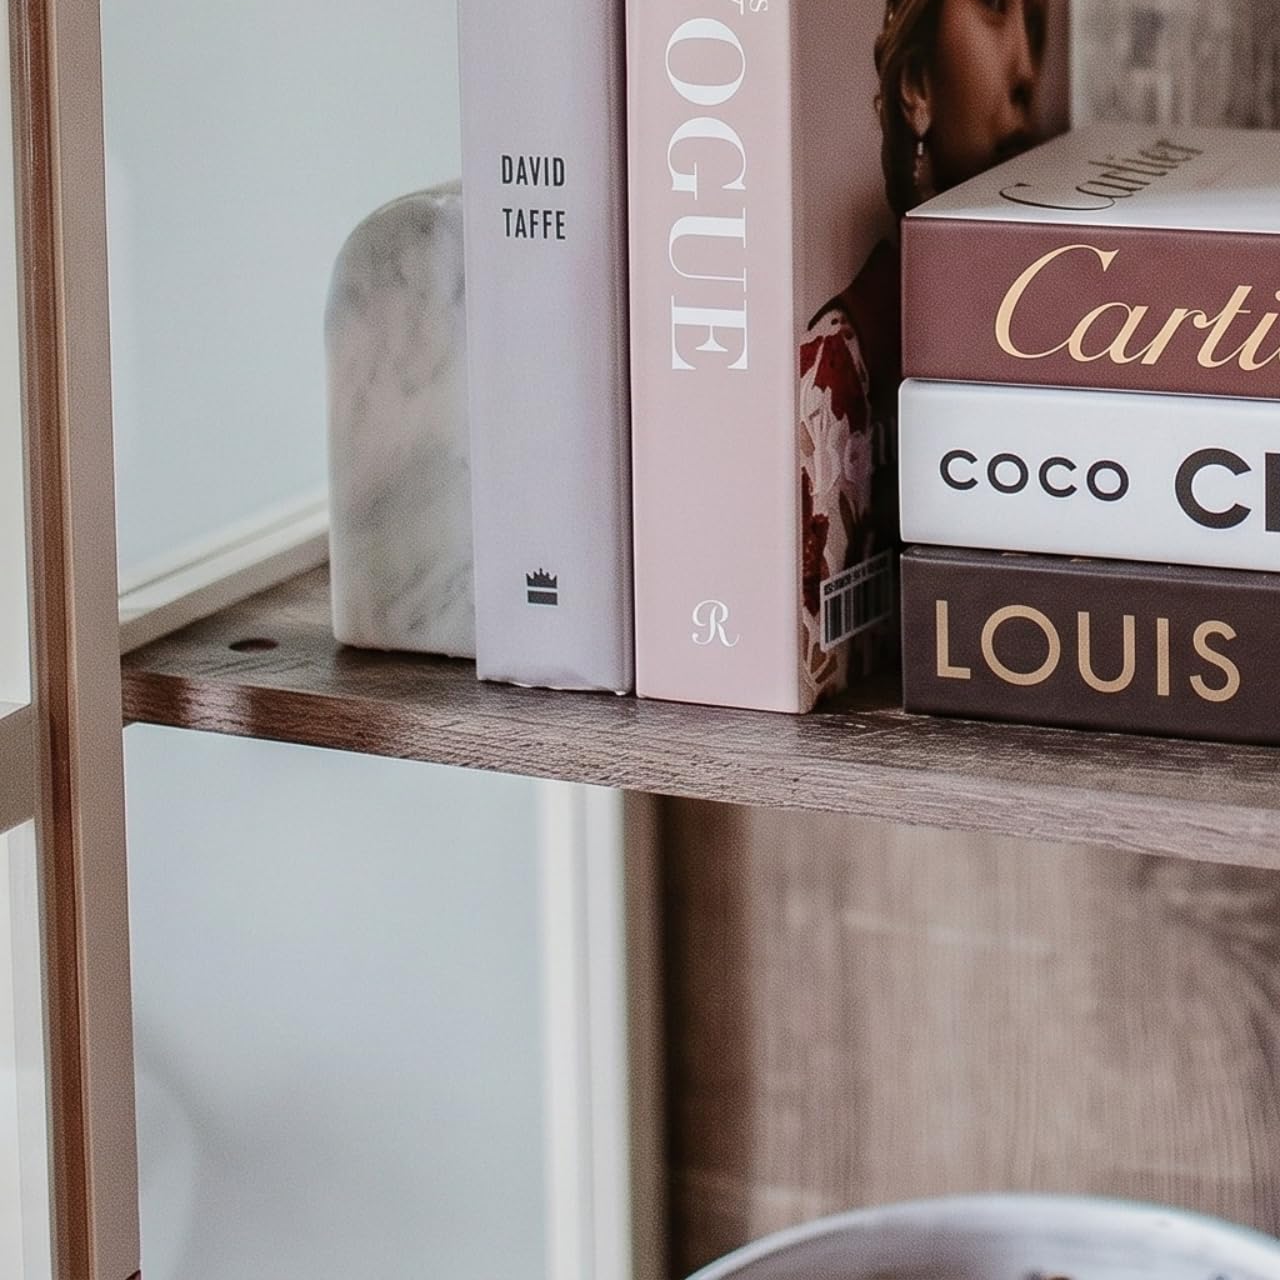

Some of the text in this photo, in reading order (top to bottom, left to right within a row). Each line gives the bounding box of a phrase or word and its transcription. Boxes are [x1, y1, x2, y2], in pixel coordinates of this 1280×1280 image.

[501, 155, 566, 187] DAVID
[999, 138, 1205, 211] Cartier
[502, 208, 566, 240] TAFFE
[936, 599, 1241, 702] LOUIS
